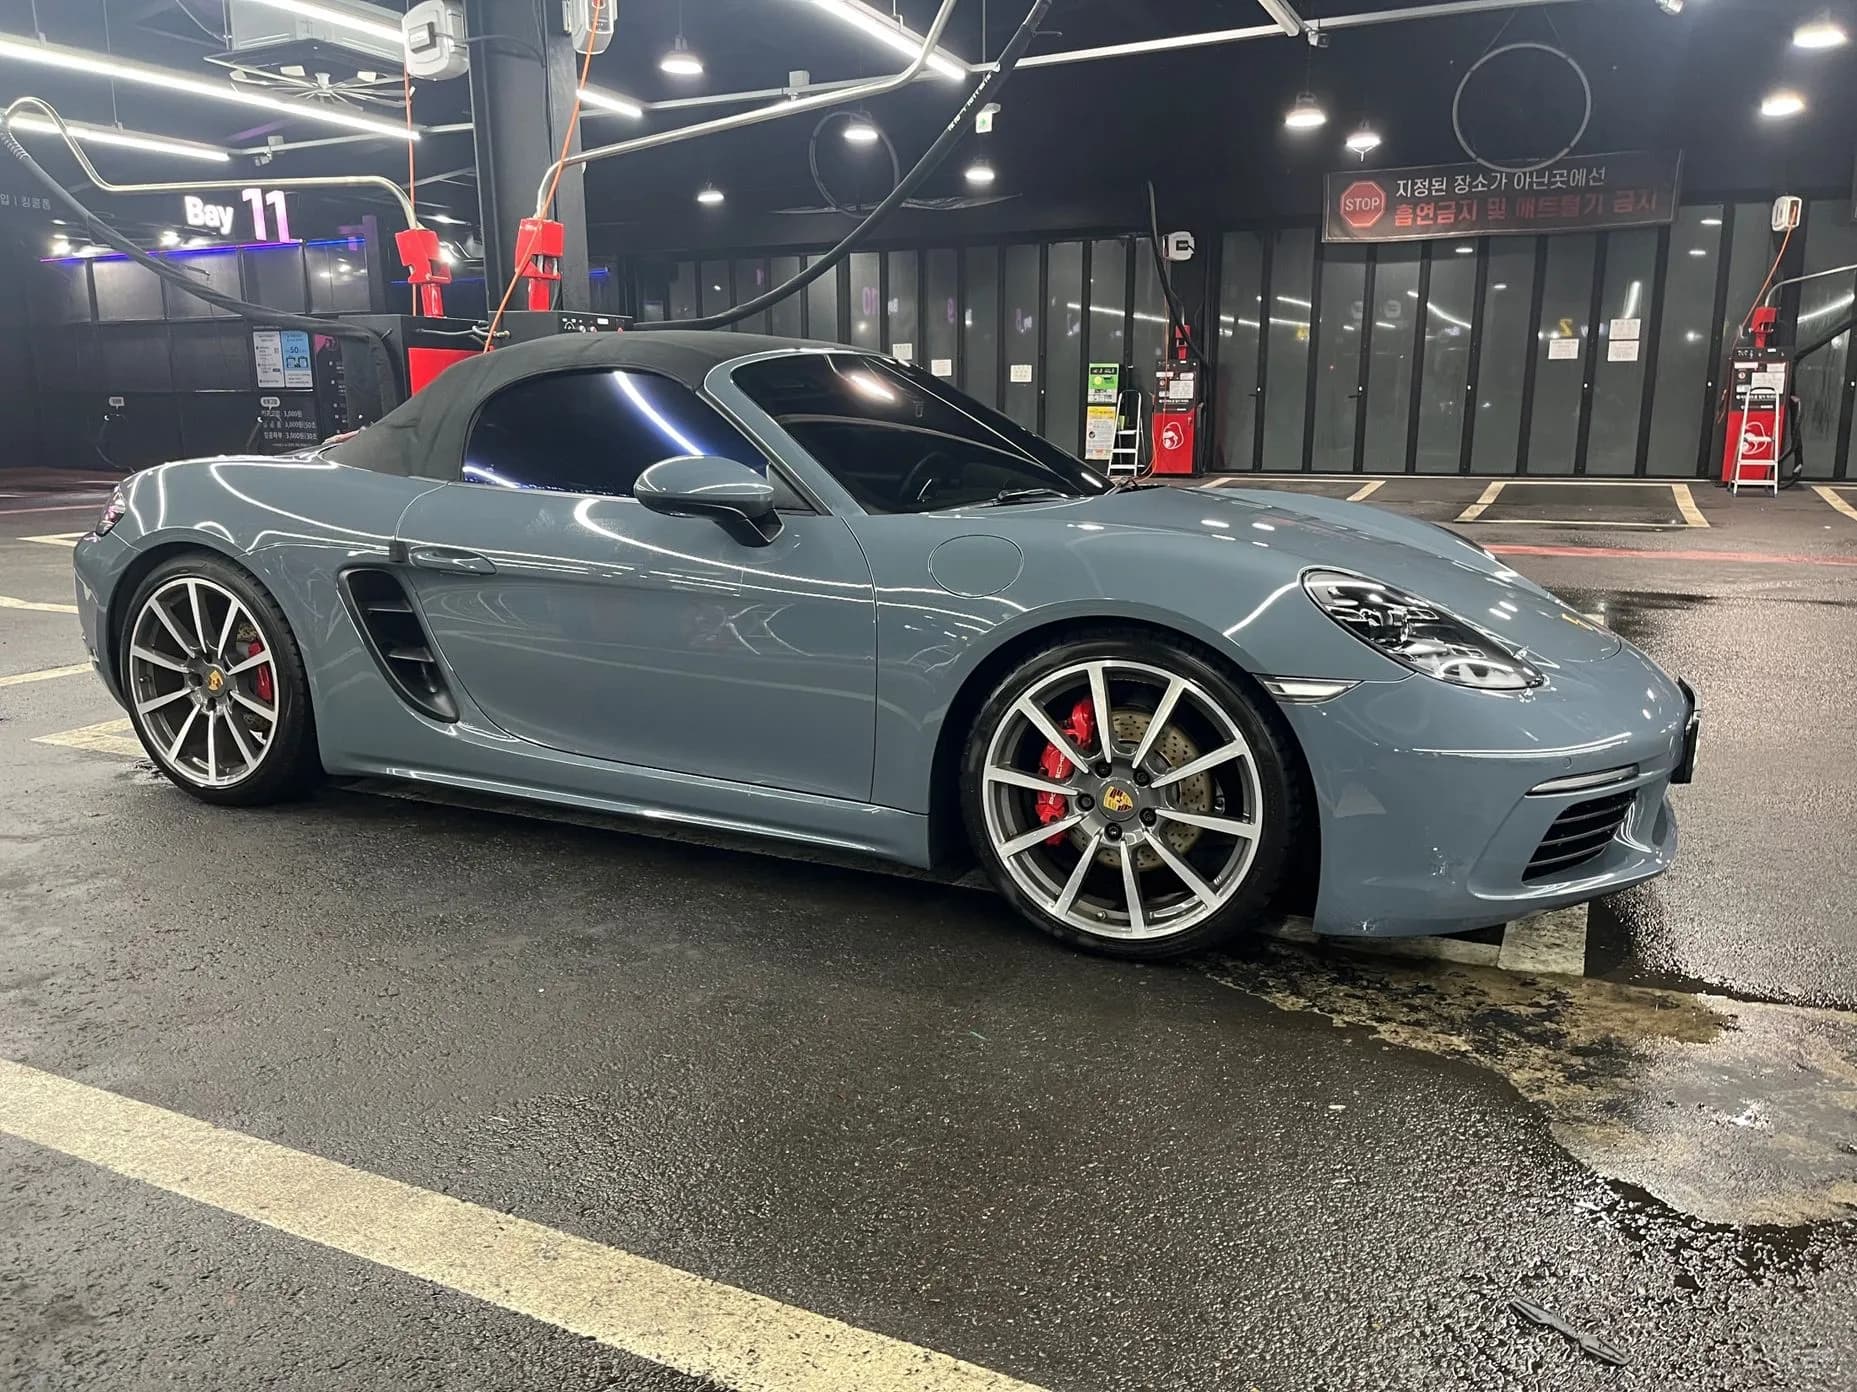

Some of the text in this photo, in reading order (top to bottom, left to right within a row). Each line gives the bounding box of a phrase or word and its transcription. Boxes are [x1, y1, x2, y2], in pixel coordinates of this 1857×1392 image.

[1396, 166, 1607, 198] 지정된 장소가 아닌곳에선
[184, 188, 291, 243] Bay 11
[1345, 197, 1380, 212] STOP
[1394, 198, 1478, 227] 흡연금지
[1487, 197, 1506, 220] 및
[1613, 189, 1657, 214] 금지
